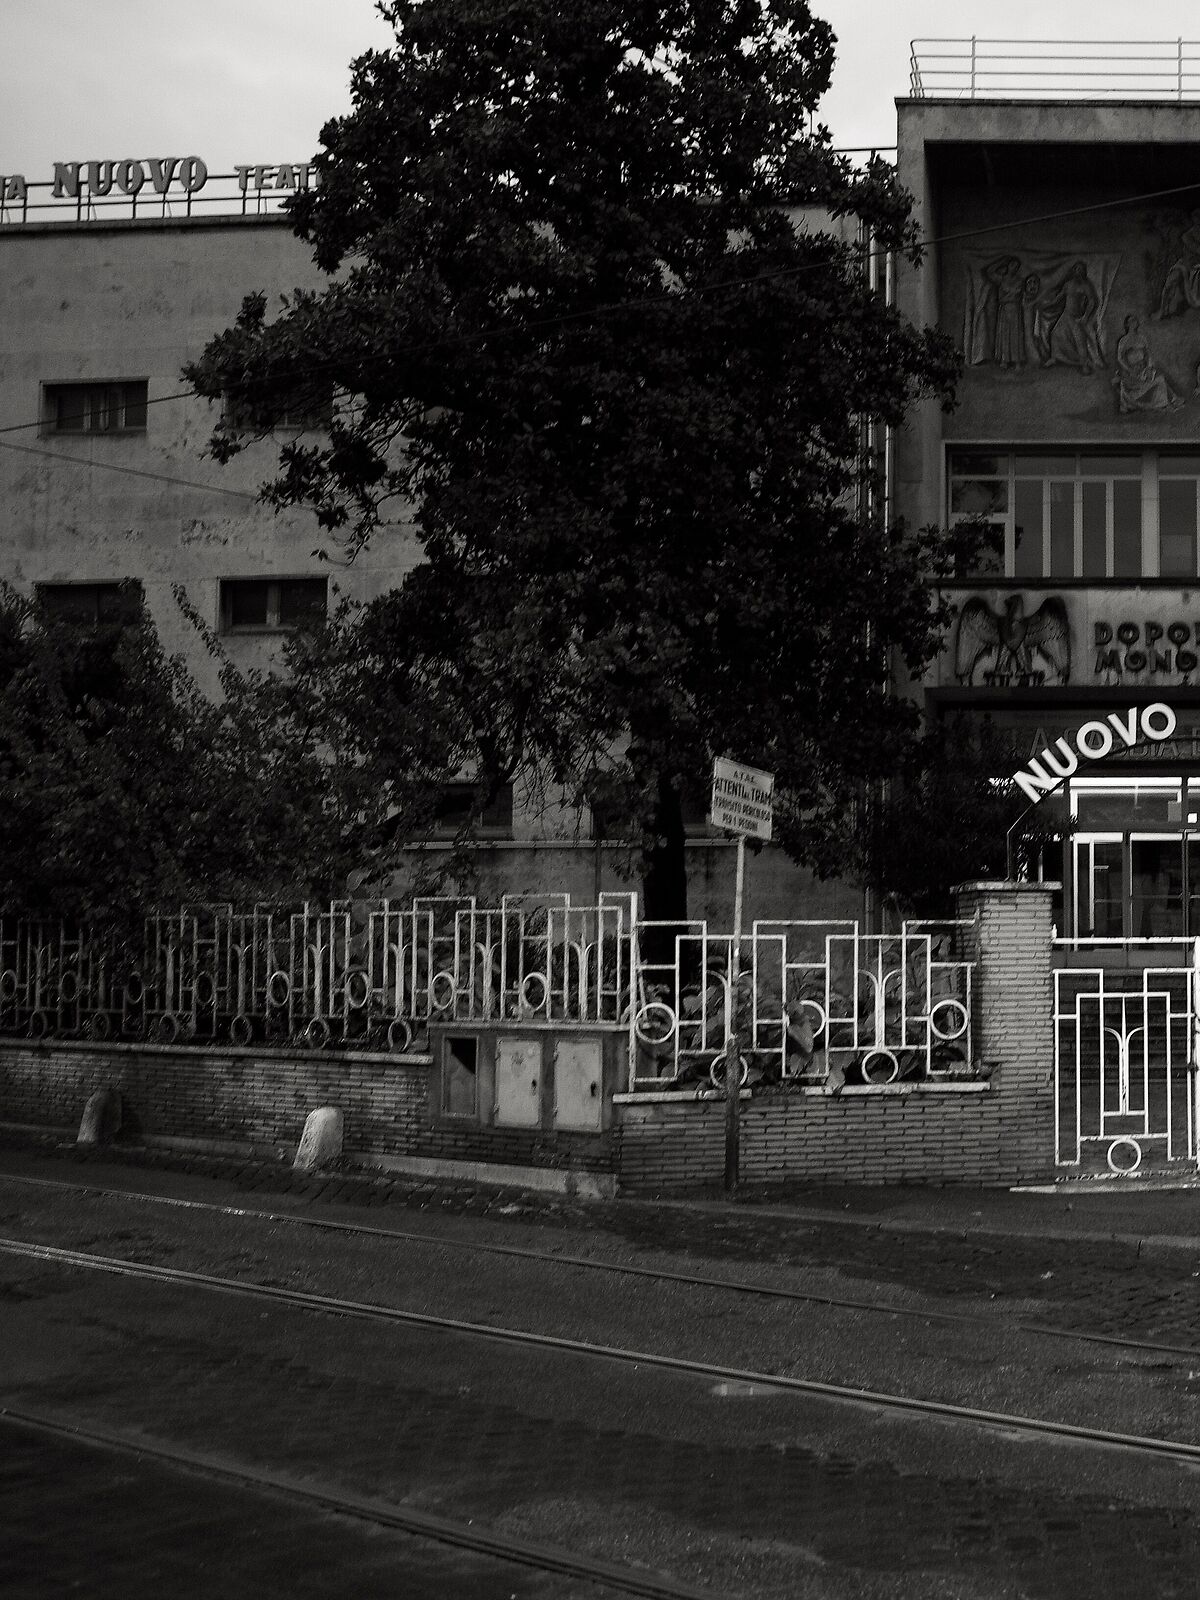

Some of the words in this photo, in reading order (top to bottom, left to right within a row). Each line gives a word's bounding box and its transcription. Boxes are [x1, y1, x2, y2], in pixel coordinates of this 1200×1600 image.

[52, 156, 208, 198] NUOVO
[234, 162, 323, 191] TEAT
[1011, 702, 1178, 804] NUOVO
